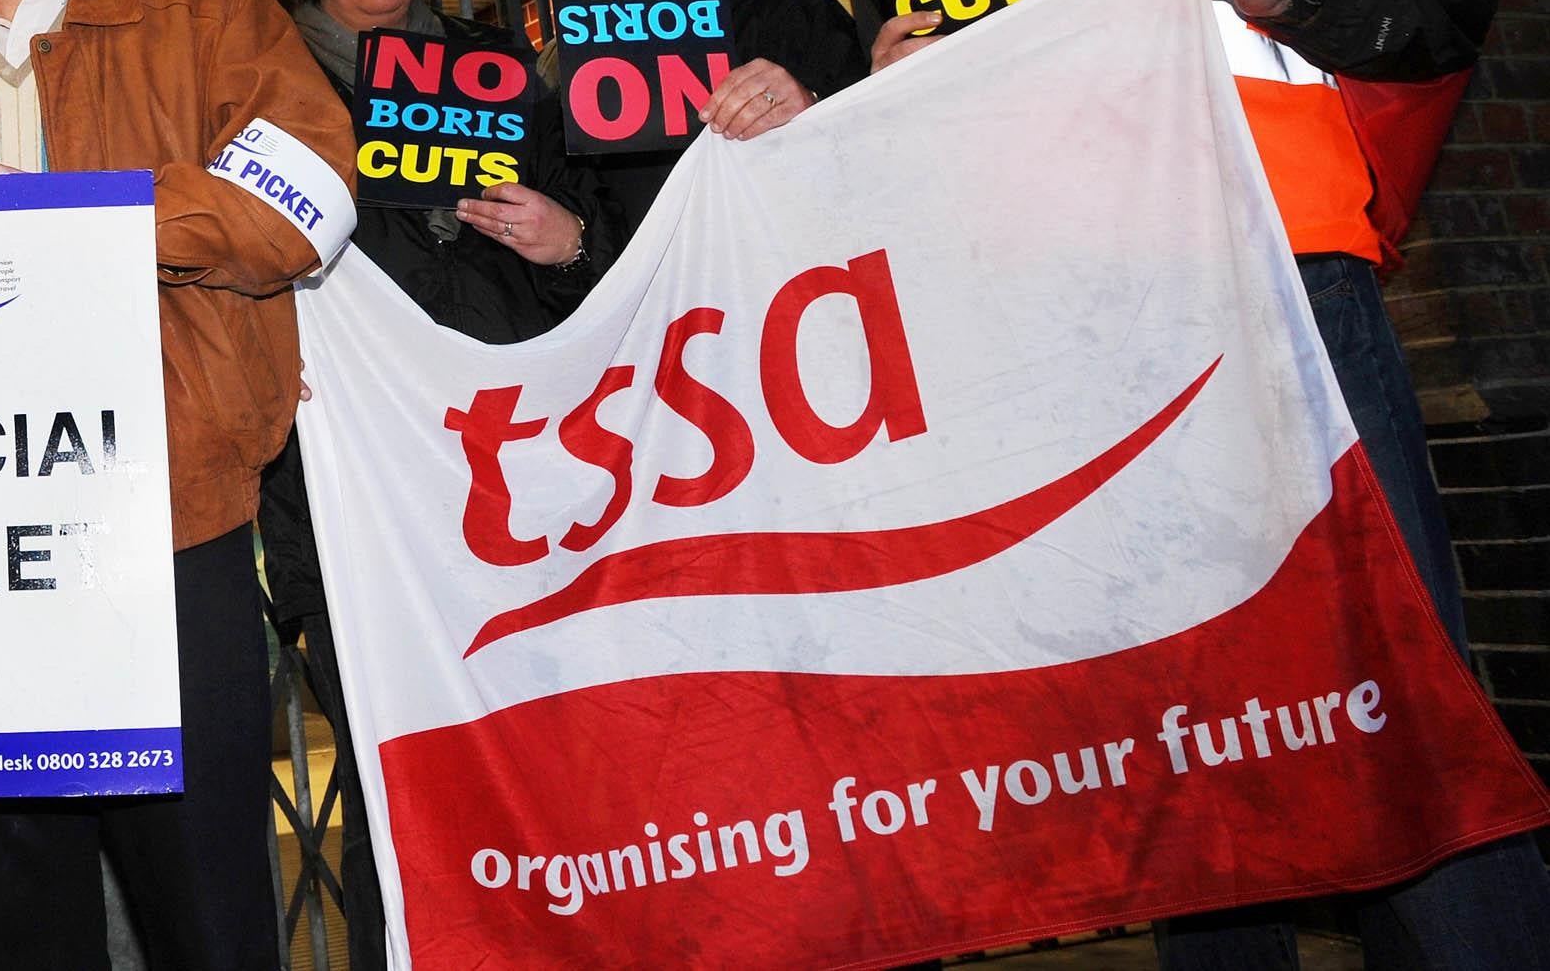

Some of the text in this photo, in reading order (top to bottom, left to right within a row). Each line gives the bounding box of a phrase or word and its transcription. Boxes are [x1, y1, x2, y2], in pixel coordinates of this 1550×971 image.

[558, 0, 725, 45] BORIS
[372, 35, 528, 103] NO
[568, 53, 731, 141] NO
[366, 98, 525, 142] BORIS
[240, 159, 323, 231] PICKET
[357, 140, 519, 188] CUTS
[444, 248, 928, 567] tssa
[37, 753, 84, 770] 0800
[88, 751, 123, 769] 328
[127, 749, 174, 768] 2673
[469, 677, 1388, 916] organising for your future
